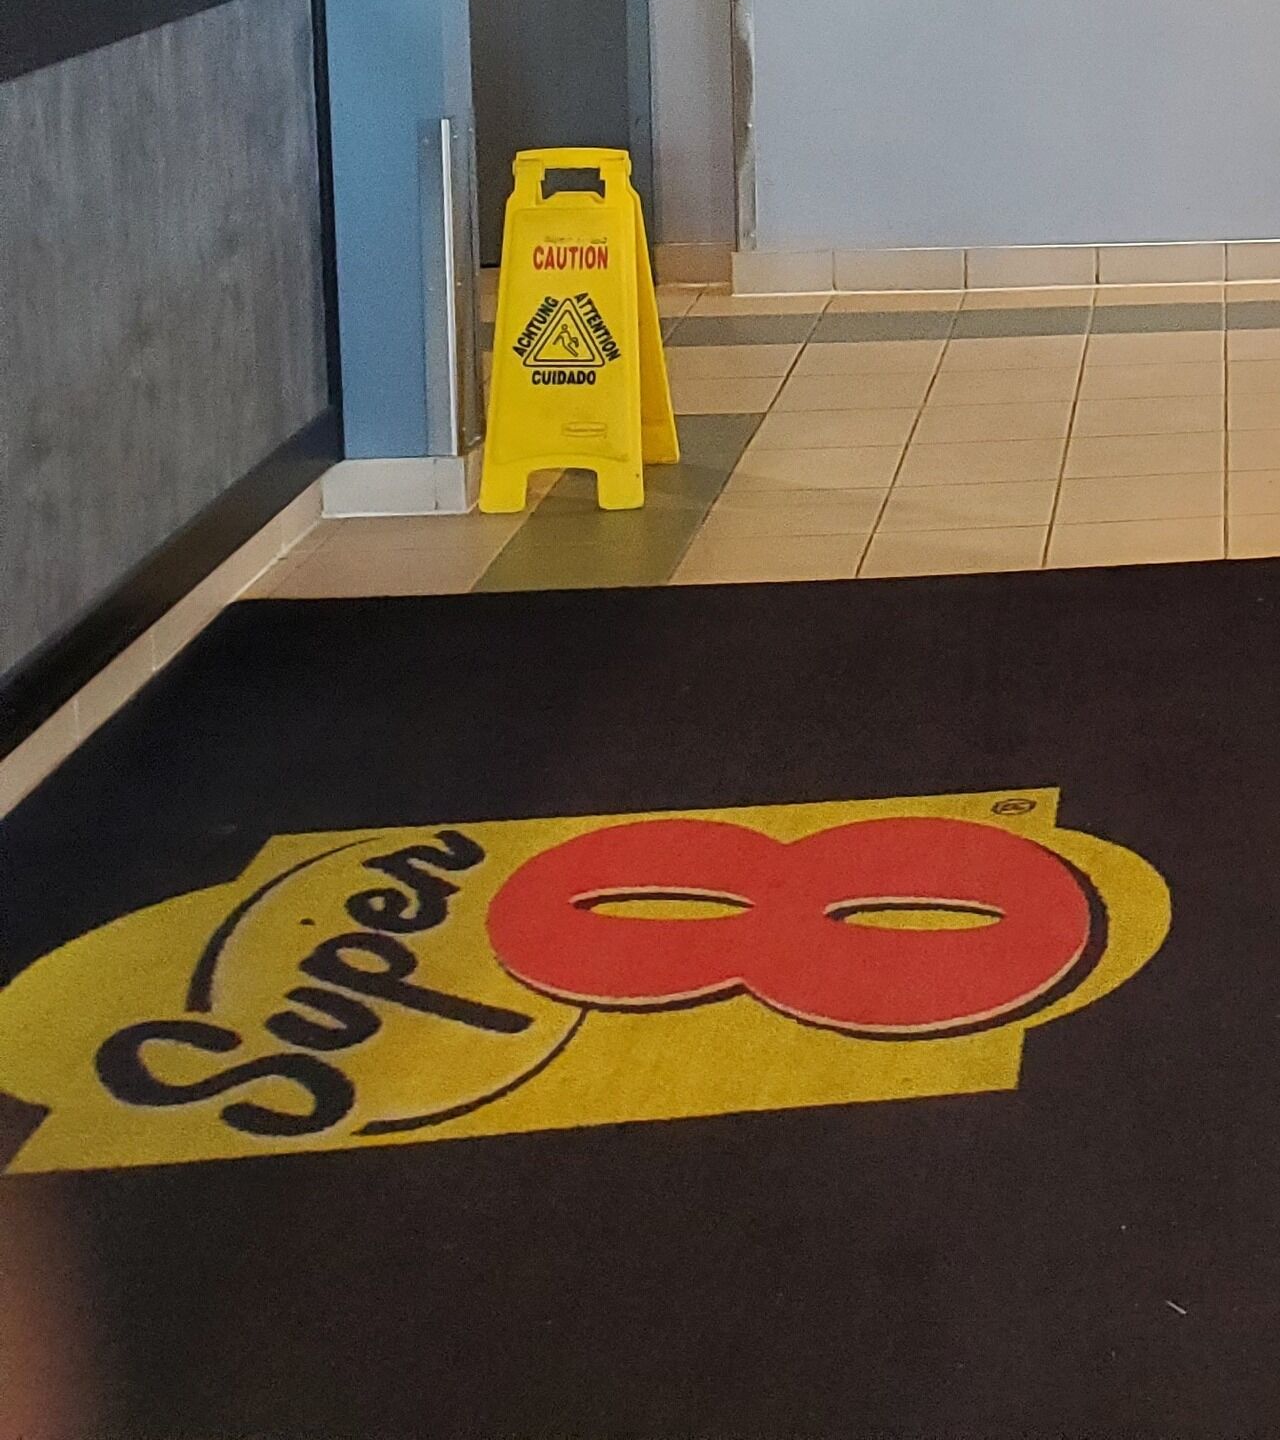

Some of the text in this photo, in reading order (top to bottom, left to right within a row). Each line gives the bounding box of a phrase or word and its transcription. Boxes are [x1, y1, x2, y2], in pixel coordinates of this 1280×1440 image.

[533, 245, 608, 270] CAUTION
[512, 296, 560, 358] ACHTUNG
[574, 292, 621, 362] ATTENTION
[531, 370, 597, 385] CUIDADO
[94, 816, 1108, 1137] Super 8
